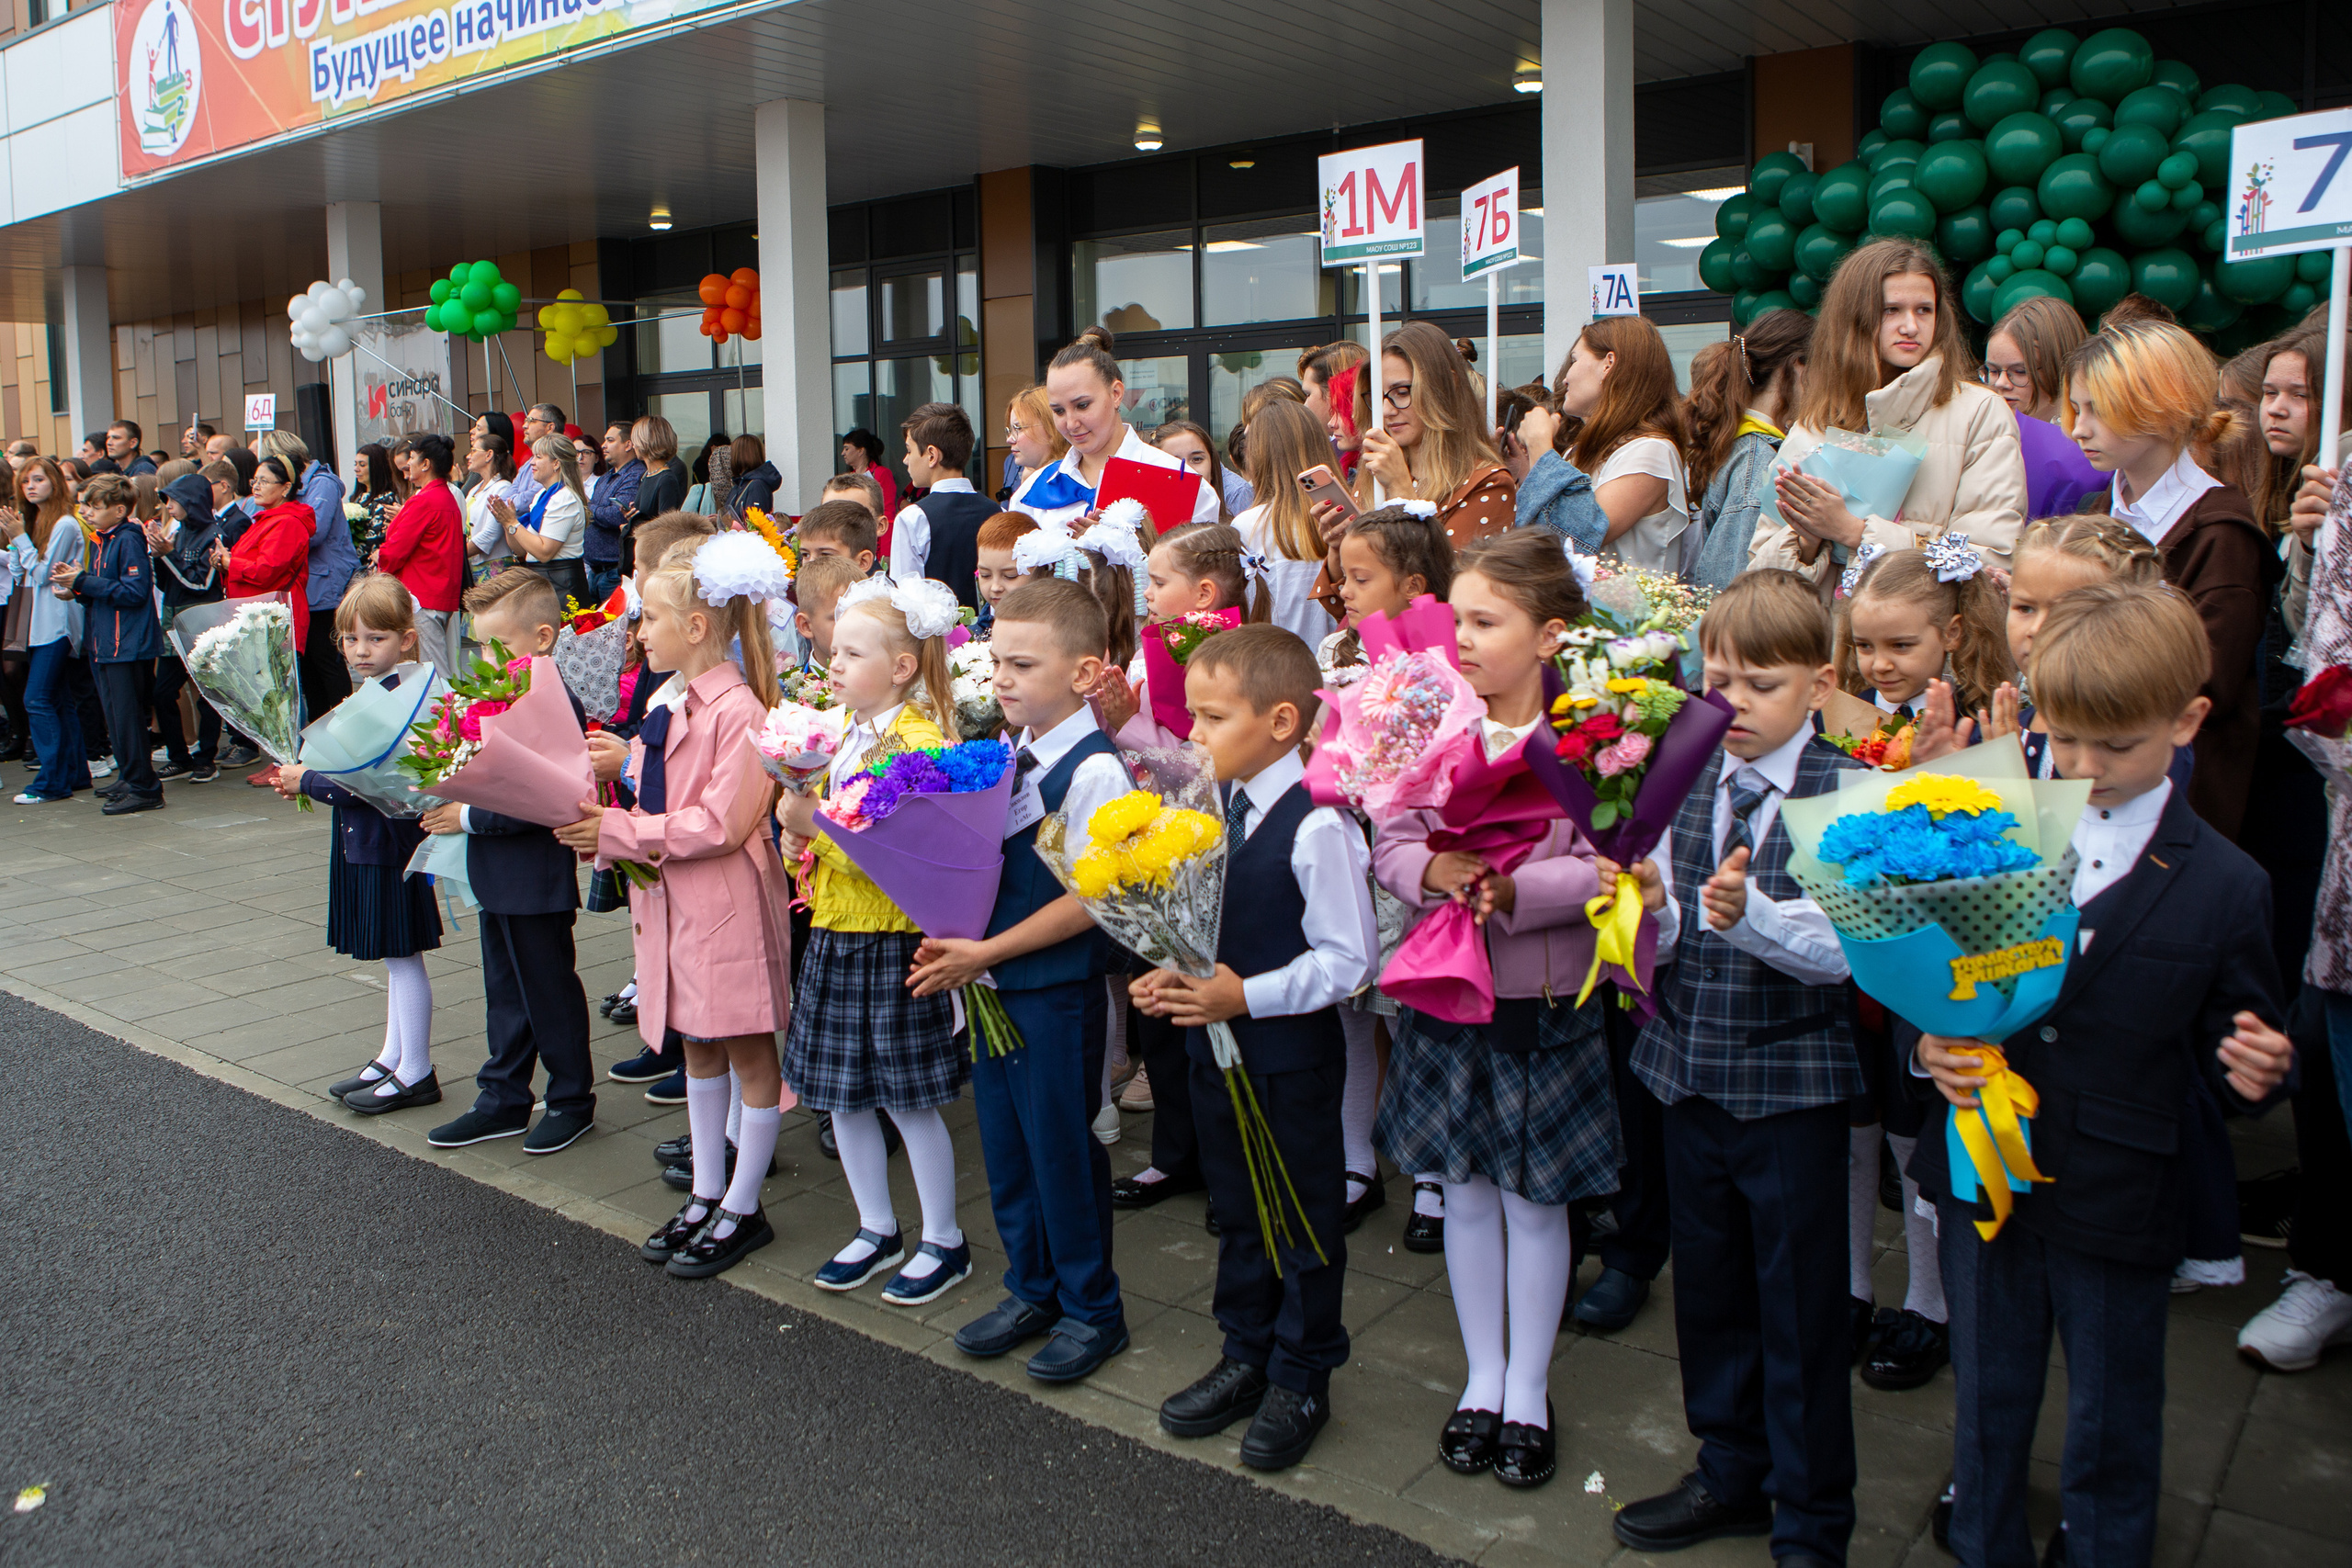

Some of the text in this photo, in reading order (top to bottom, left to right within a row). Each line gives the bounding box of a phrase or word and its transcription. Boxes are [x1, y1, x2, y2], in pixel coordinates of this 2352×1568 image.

[313, 18, 446, 100] Будущее
[457, 0, 602, 46] начин
[185, 68, 192, 90] 3
[176, 95, 185, 117] 2
[171, 122, 177, 142] 1
[1338, 162, 1417, 238] 1М
[1474, 186, 1510, 251] 7Б
[1366, 242, 1417, 254] МАОУ СОШ №123
[1602, 274, 1634, 309] 7А
[389, 375, 440, 400] синара
[252, 399, 272, 421] 6Д
[390, 402, 412, 418] банк
[1014, 804, 1027, 817] Егор
